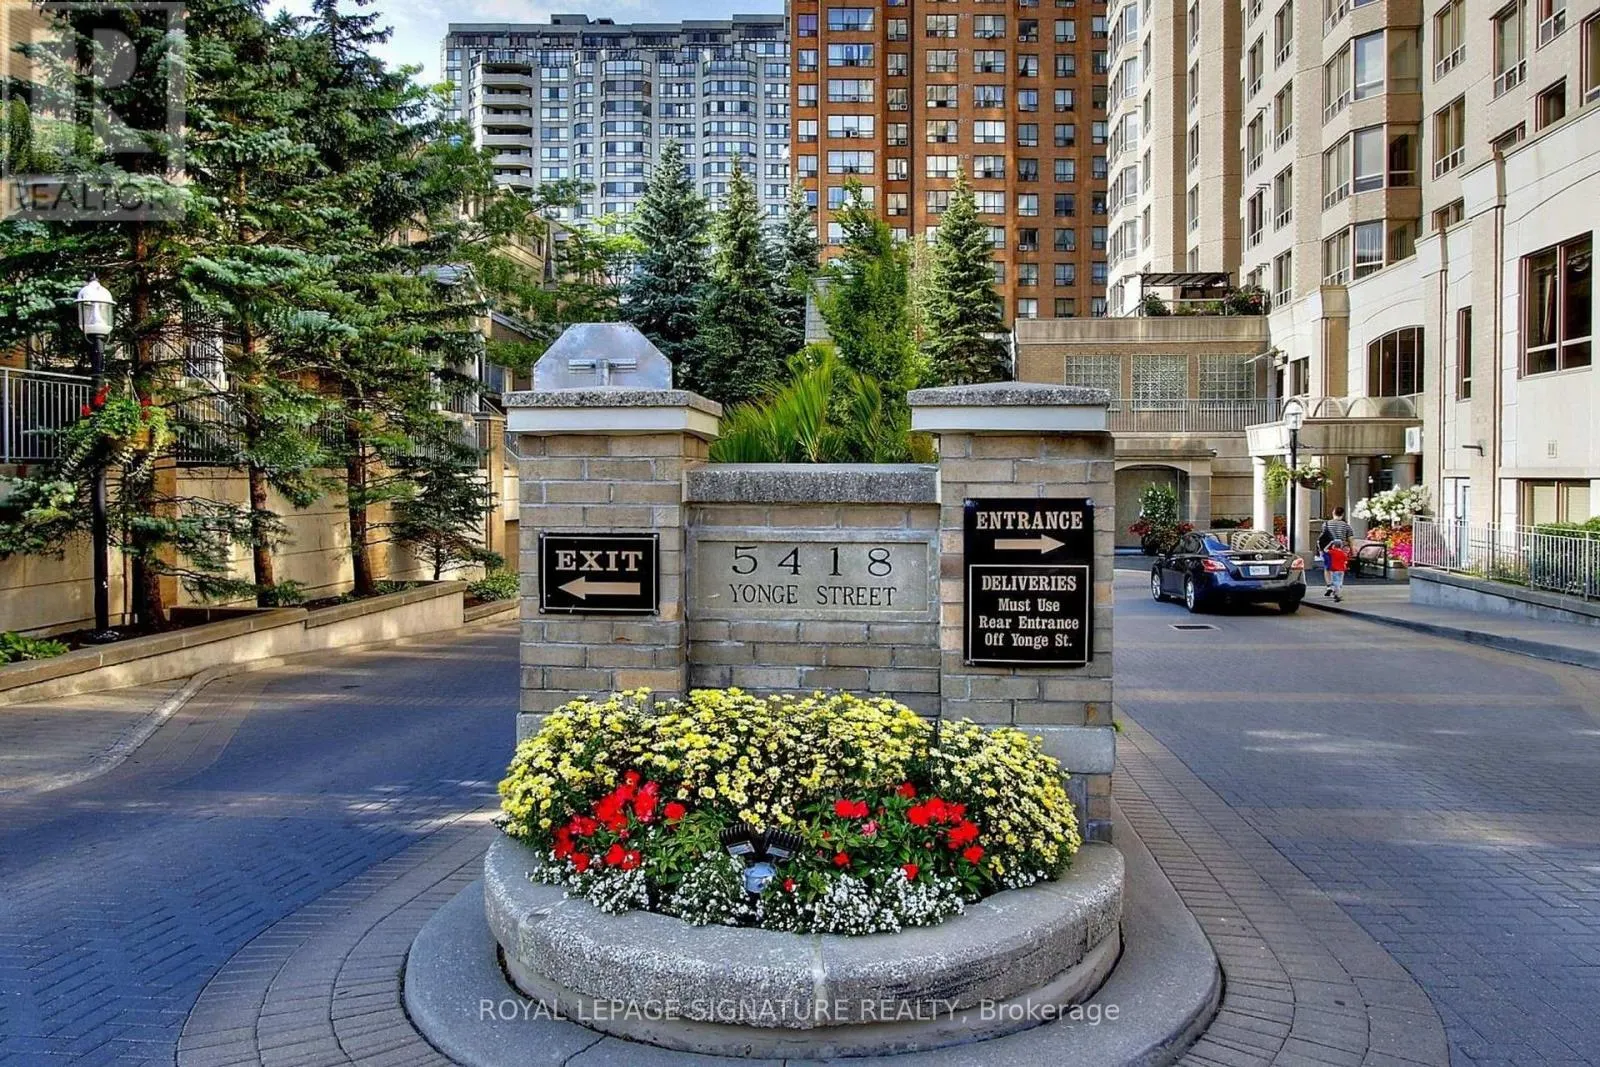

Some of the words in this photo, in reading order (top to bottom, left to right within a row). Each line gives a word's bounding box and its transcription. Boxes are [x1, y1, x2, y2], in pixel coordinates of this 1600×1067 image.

[976, 511, 1083, 530] ENTRANCE
[555, 550, 643, 572] EXIT
[731, 545, 893, 577] 5418
[981, 575, 1077, 592] DELIVERIES
[729, 584, 799, 604] YONGE
[816, 585, 898, 607] STREET
[998, 598, 1031, 612] Must
[1037, 598, 1061, 612] Use
[979, 615, 1012, 629] Rear
[1018, 615, 1080, 630] Entrance
[984, 632, 1005, 646] Off
[1011, 633, 1049, 650] Yonge
[1055, 633, 1073, 647] St.
